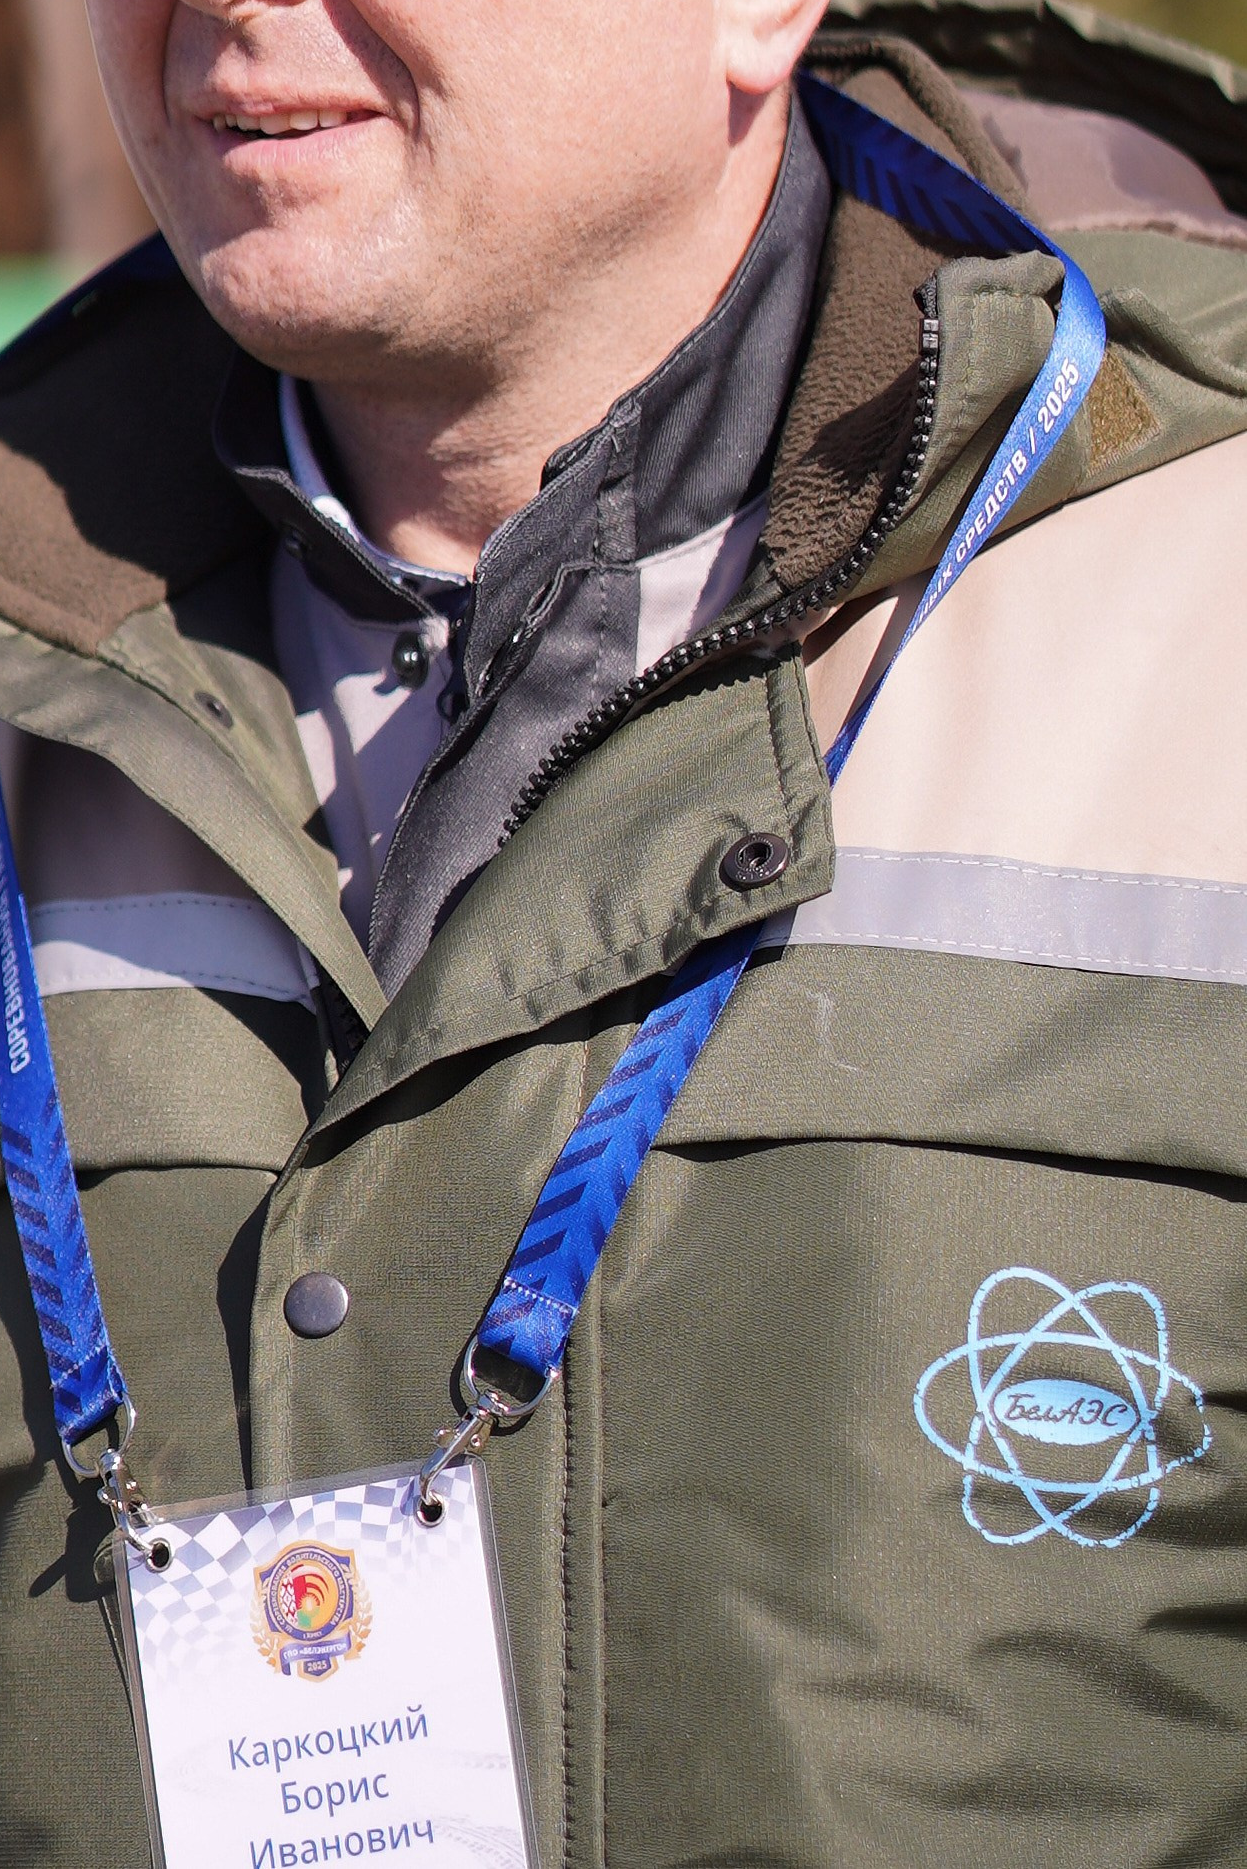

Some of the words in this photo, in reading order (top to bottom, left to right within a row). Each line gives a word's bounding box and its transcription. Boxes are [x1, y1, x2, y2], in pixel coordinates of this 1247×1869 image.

[955, 448, 1028, 564] СРЕДСТВ
[1037, 358, 1081, 434] 2025
[1006, 1392, 1129, 1427] БелАЭС
[306, 1660, 328, 1672] 2025
[228, 1704, 429, 1773] Каркоцкий
[280, 1772, 390, 1817] Борис
[249, 1819, 435, 1869] Иванович
